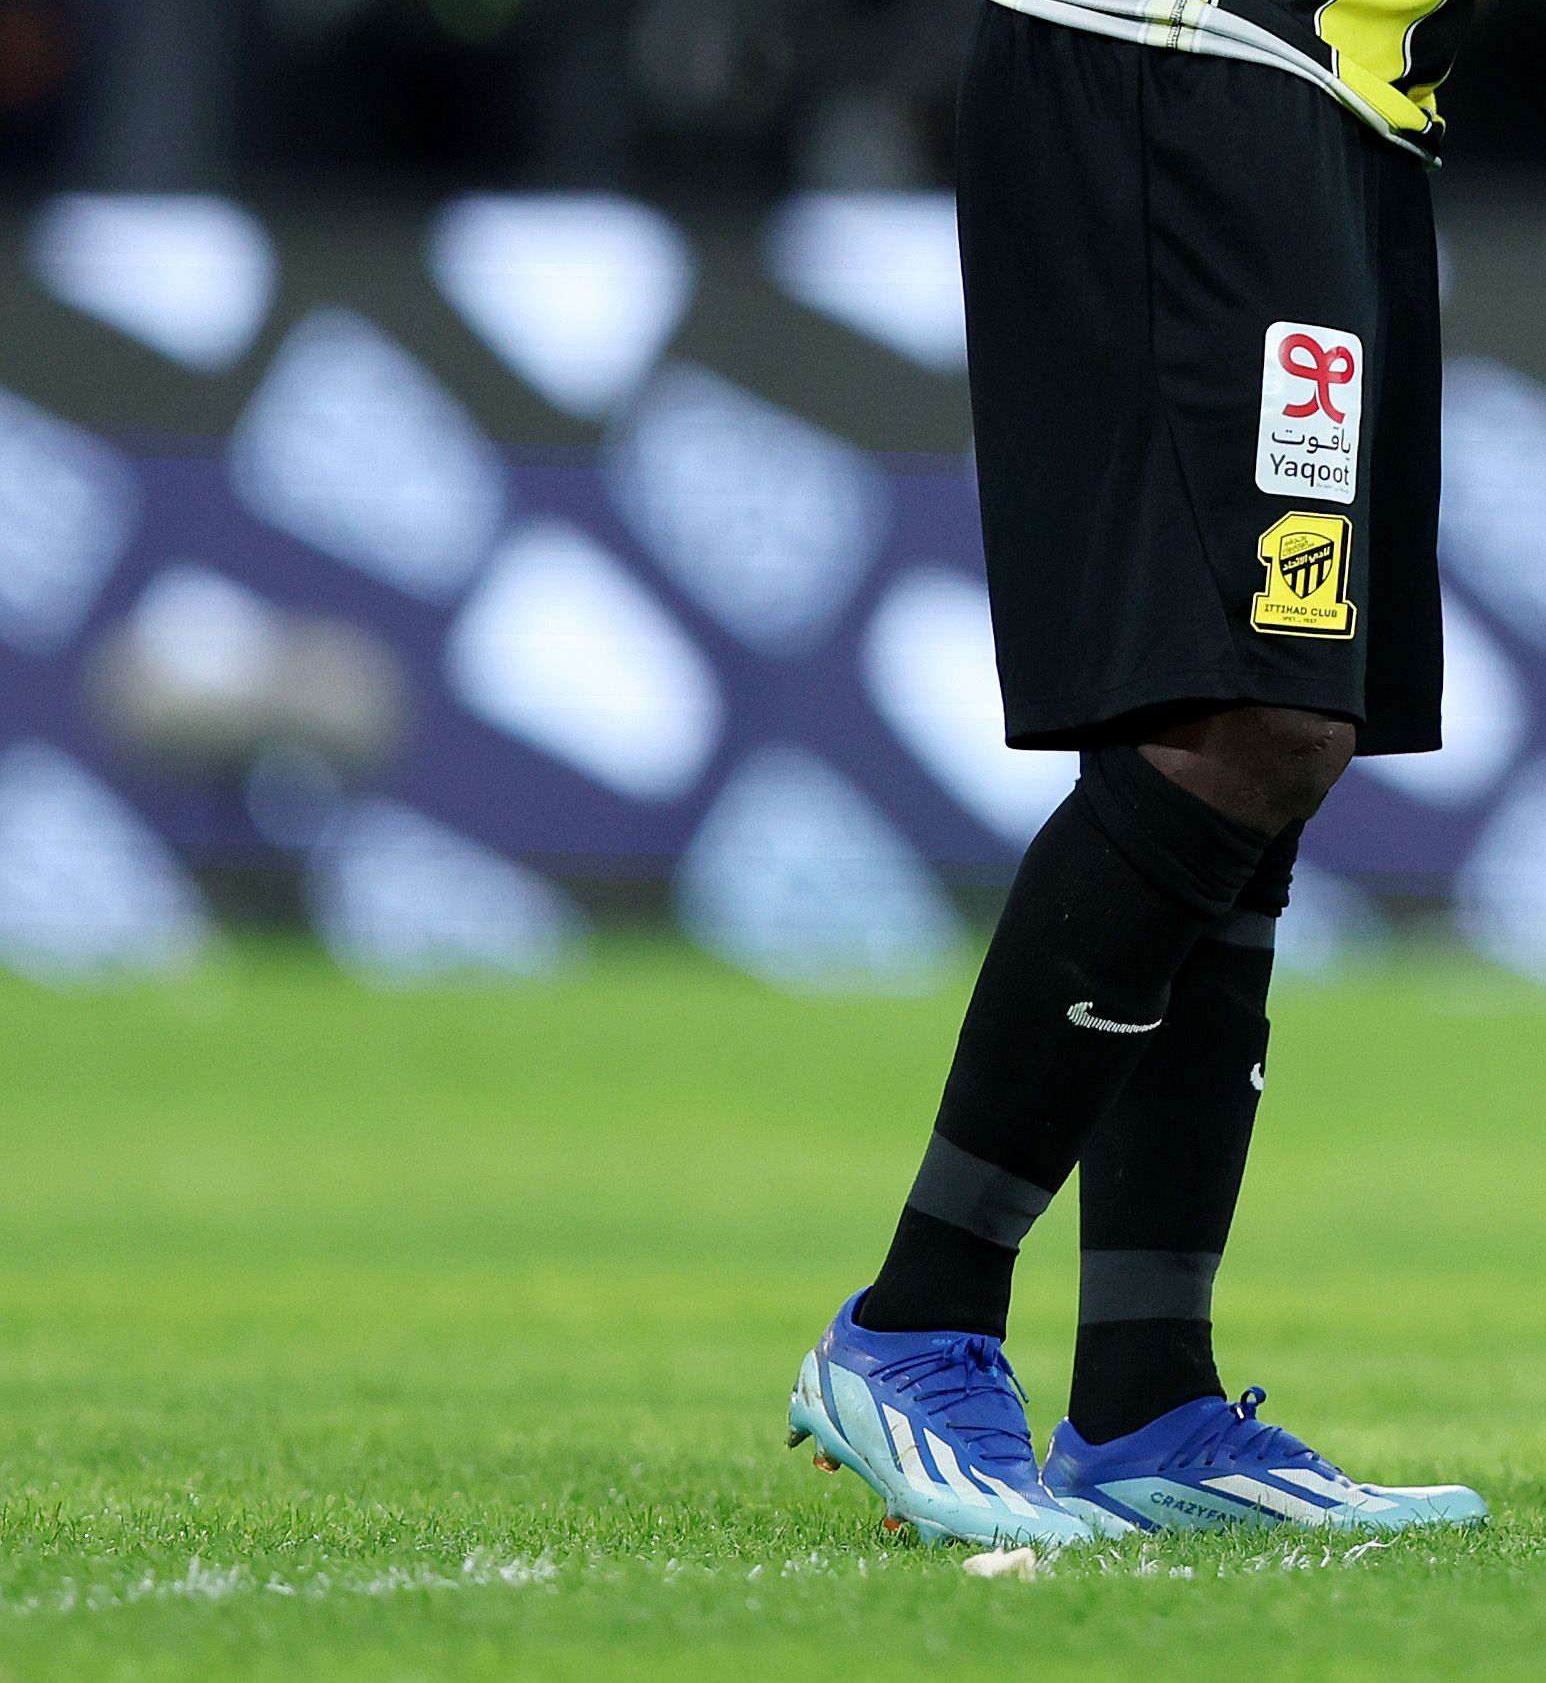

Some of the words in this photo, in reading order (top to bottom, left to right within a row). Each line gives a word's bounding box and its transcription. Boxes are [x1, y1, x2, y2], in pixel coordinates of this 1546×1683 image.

[1271, 425, 1351, 462] ياقوت
[1270, 453, 1349, 488] Yaqoot
[1265, 604, 1307, 615] ITTIHAD
[1311, 608, 1338, 618] CLUB
